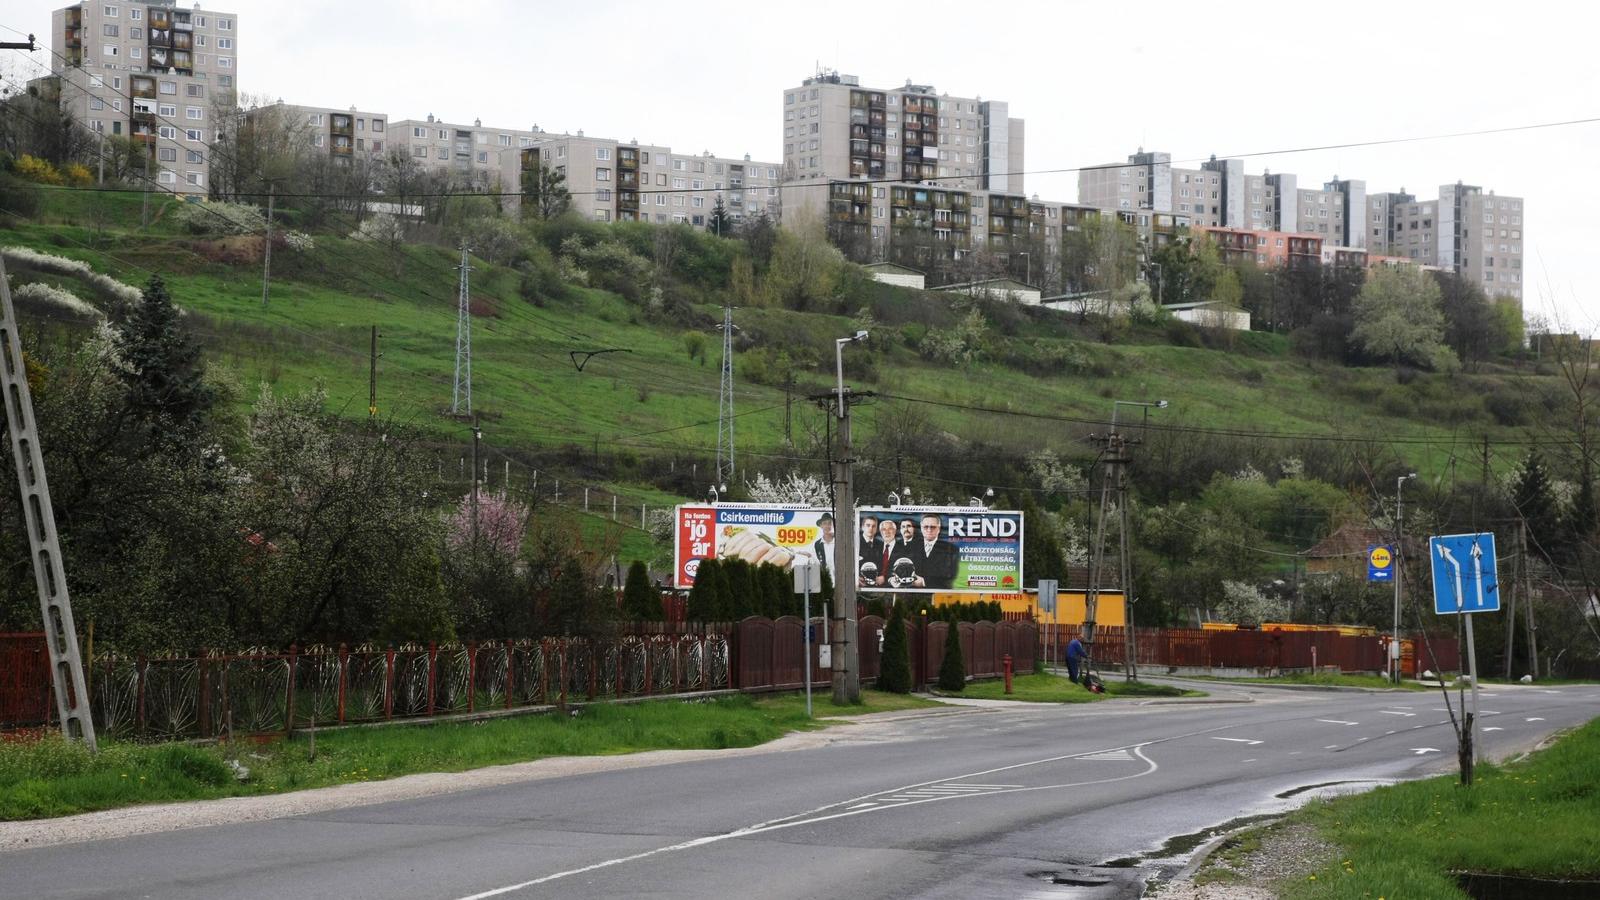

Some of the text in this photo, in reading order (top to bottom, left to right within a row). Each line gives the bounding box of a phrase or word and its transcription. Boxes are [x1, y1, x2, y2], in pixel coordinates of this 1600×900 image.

[720, 511, 784, 523] Csirkemellfilé
[689, 520, 706, 541] jó
[948, 518, 1017, 537] REND
[778, 529, 806, 543] 999
[692, 538, 711, 555] ár
[959, 546, 1016, 554] KÖZBIZTONSÁG,
[961, 554, 1016, 563] LÉTBIZTONSÁG,
[968, 563, 1016, 572] ÖSSZEFOGÁS!
